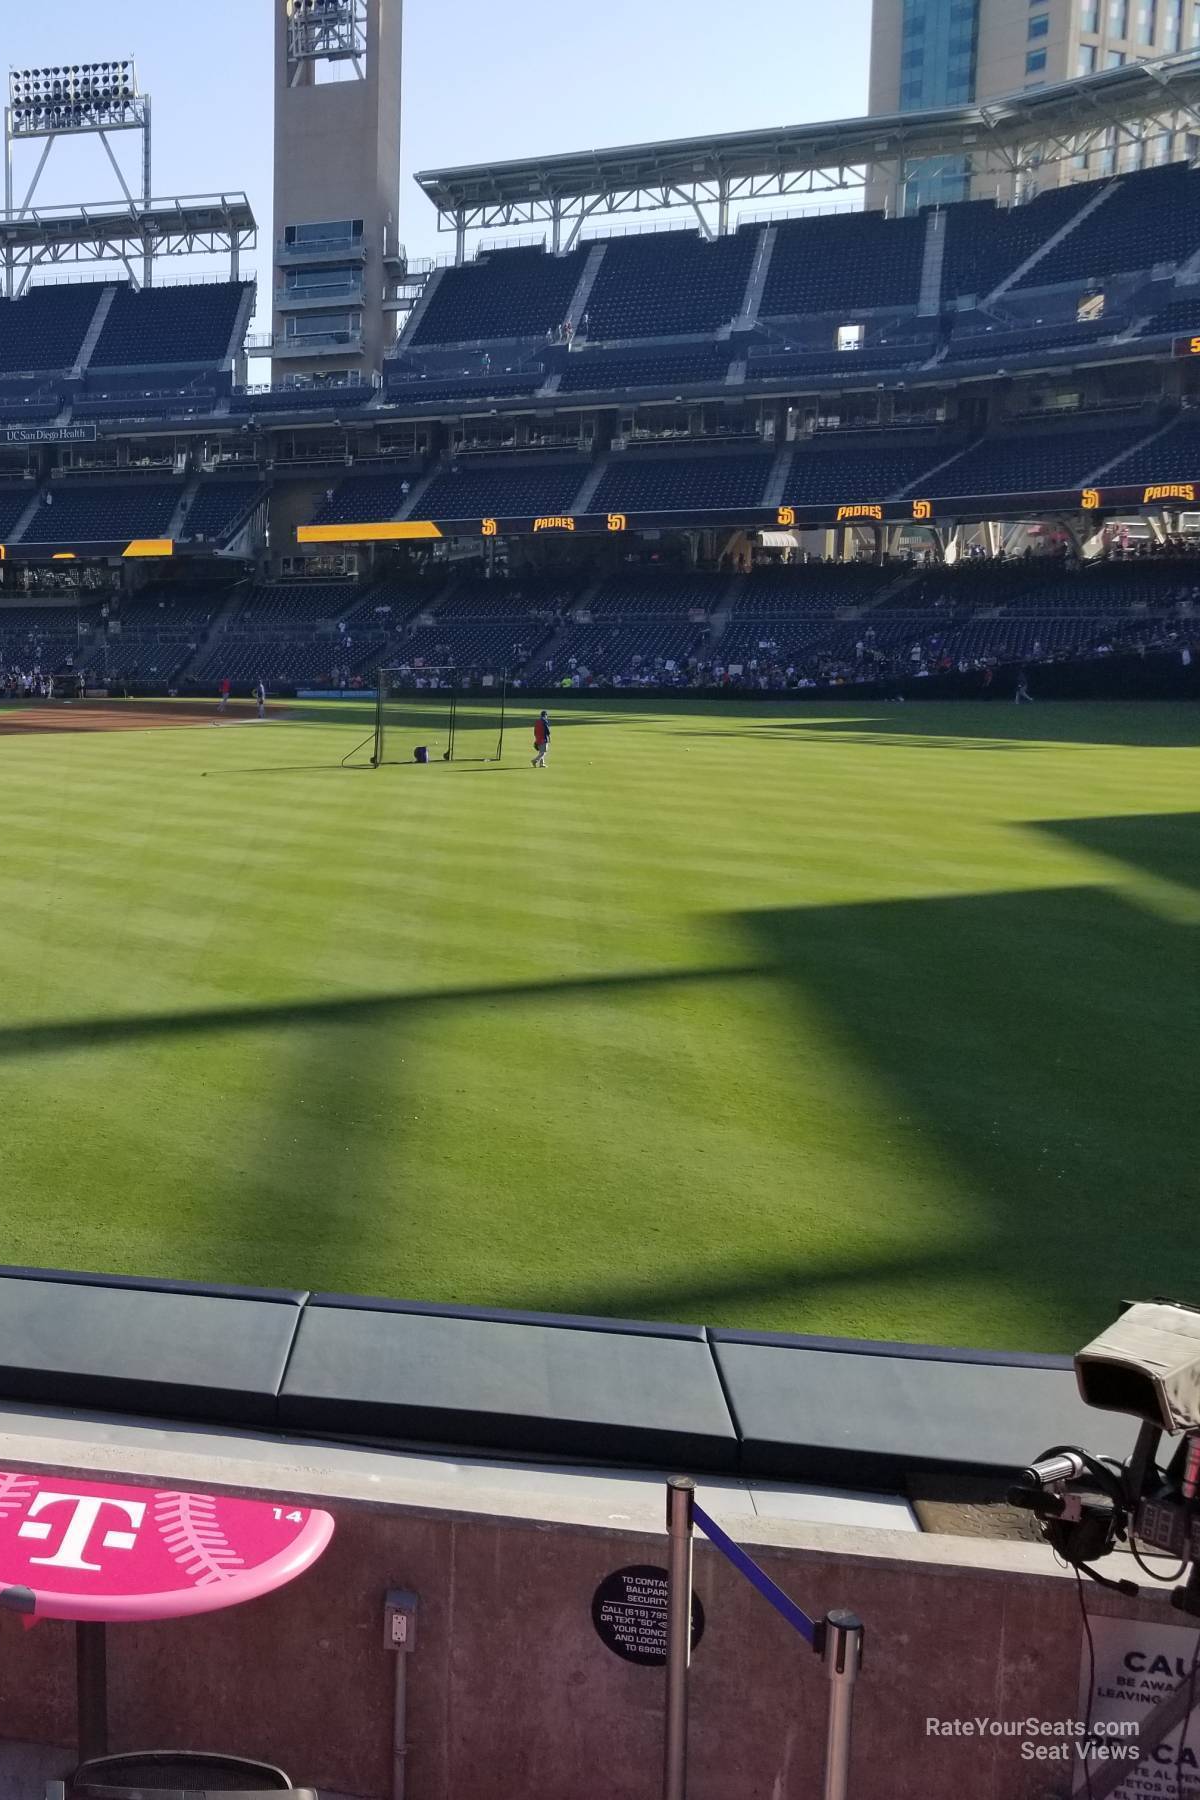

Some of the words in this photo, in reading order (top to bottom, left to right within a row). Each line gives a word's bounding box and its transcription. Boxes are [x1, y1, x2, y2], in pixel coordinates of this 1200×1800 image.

[7, 432, 19, 440] UC
[20, 430, 36, 440] San
[36, 429, 60, 441] Diego
[60, 429, 85, 438] Health
[1143, 484, 1195, 503] PADRES
[837, 505, 882, 521] PADRES
[533, 517, 575, 533] PADRES
[272, 1507, 303, 1524] 14
[18, 1491, 147, 1571] T
[623, 1576, 634, 1584] TO
[627, 1594, 668, 1606] SECURITY
[602, 1605, 623, 1615] CALL
[600, 1614, 613, 1622] OR
[614, 1615, 636, 1625] TEXT
[613, 1624, 638, 1634] YOUR
[638, 1627, 668, 1638] CONCE
[614, 1633, 635, 1643] AND
[625, 1643, 637, 1652] TO
[1116, 1676, 1136, 1687] BE
